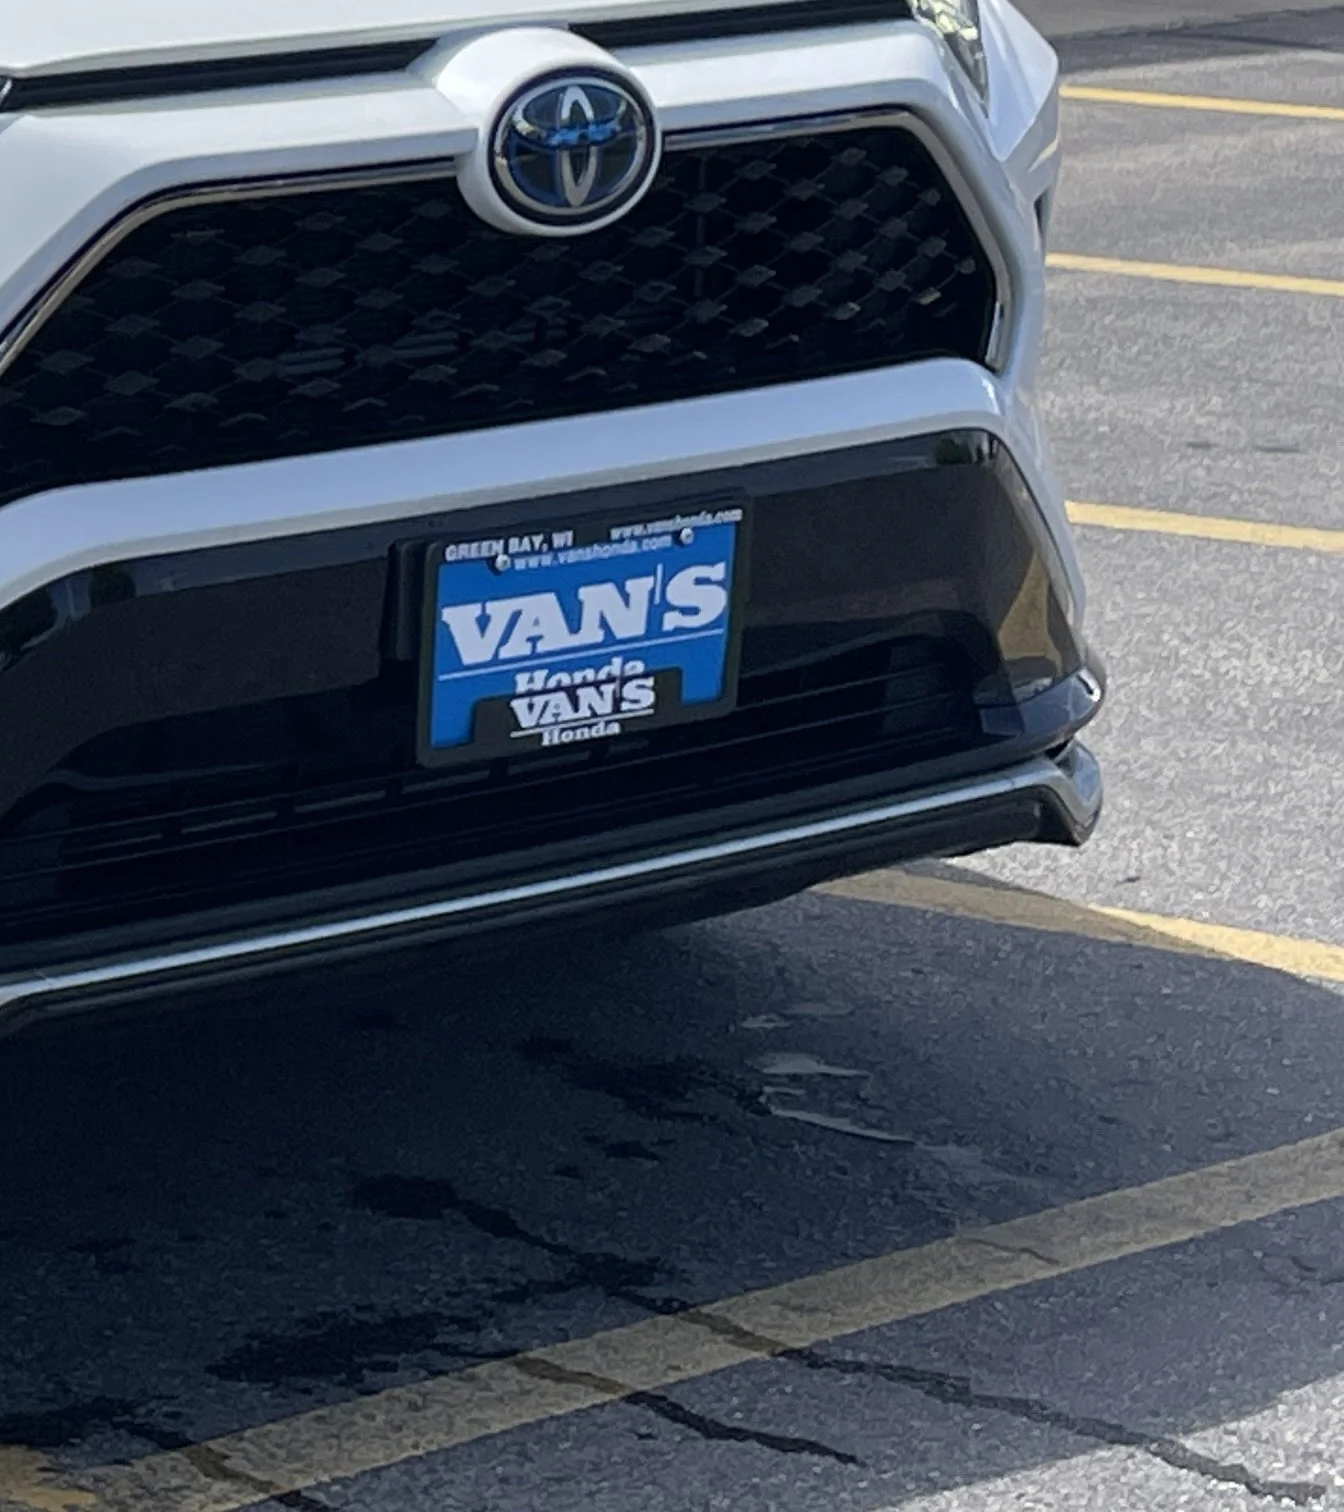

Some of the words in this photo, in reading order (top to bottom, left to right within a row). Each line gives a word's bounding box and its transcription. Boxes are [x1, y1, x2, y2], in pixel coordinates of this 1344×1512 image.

[445, 539, 505, 562] GREEN
[552, 530, 574, 549] WI
[514, 534, 672, 571] www.vanshonda.com
[441, 561, 728, 666] VAN'S
[515, 656, 646, 694] Honda
[510, 676, 655, 729] VAN'S
[541, 721, 621, 746] Honda
